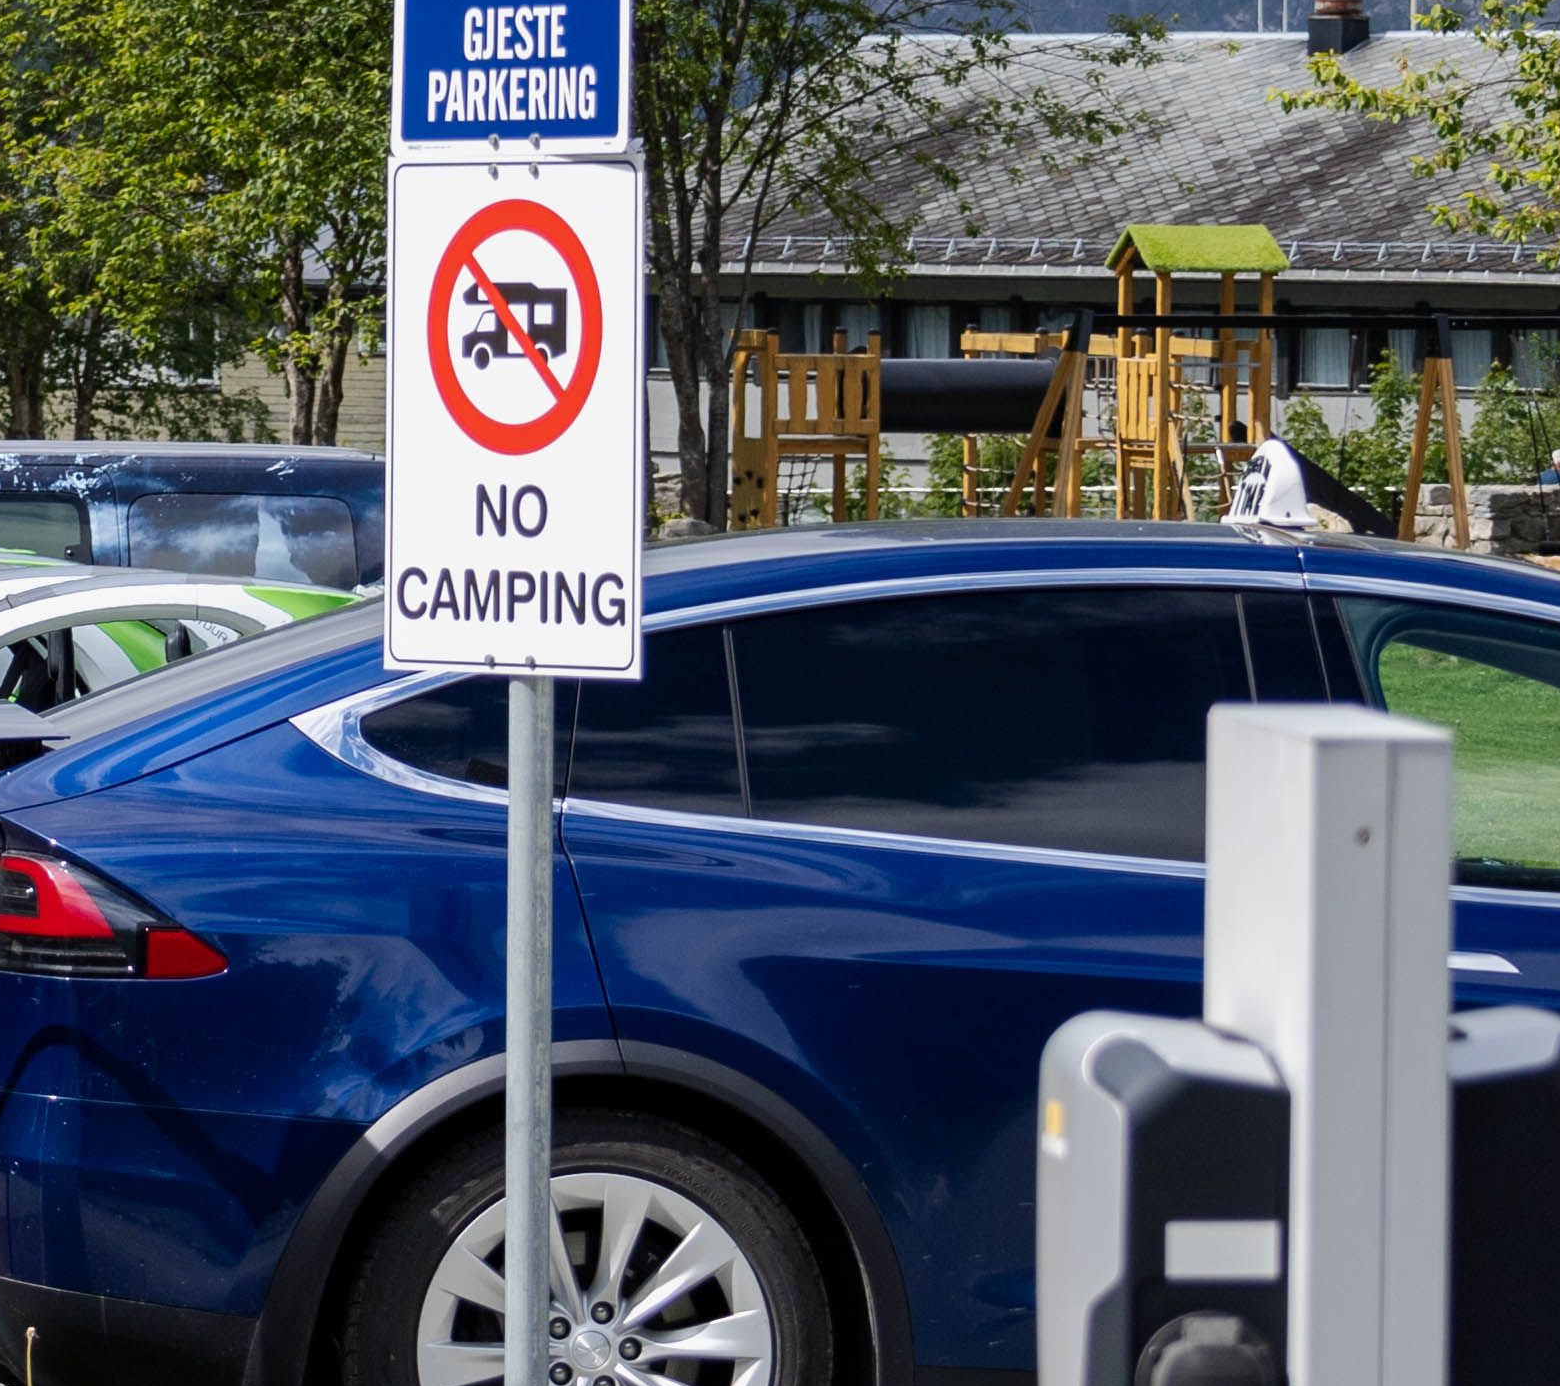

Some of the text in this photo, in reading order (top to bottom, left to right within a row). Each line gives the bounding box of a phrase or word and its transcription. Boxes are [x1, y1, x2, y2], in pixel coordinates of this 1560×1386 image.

[463, 3, 568, 64] GJESTE
[426, 63, 598, 125] PARKERING
[474, 483, 549, 538] NO
[396, 565, 627, 628] CAMPING
